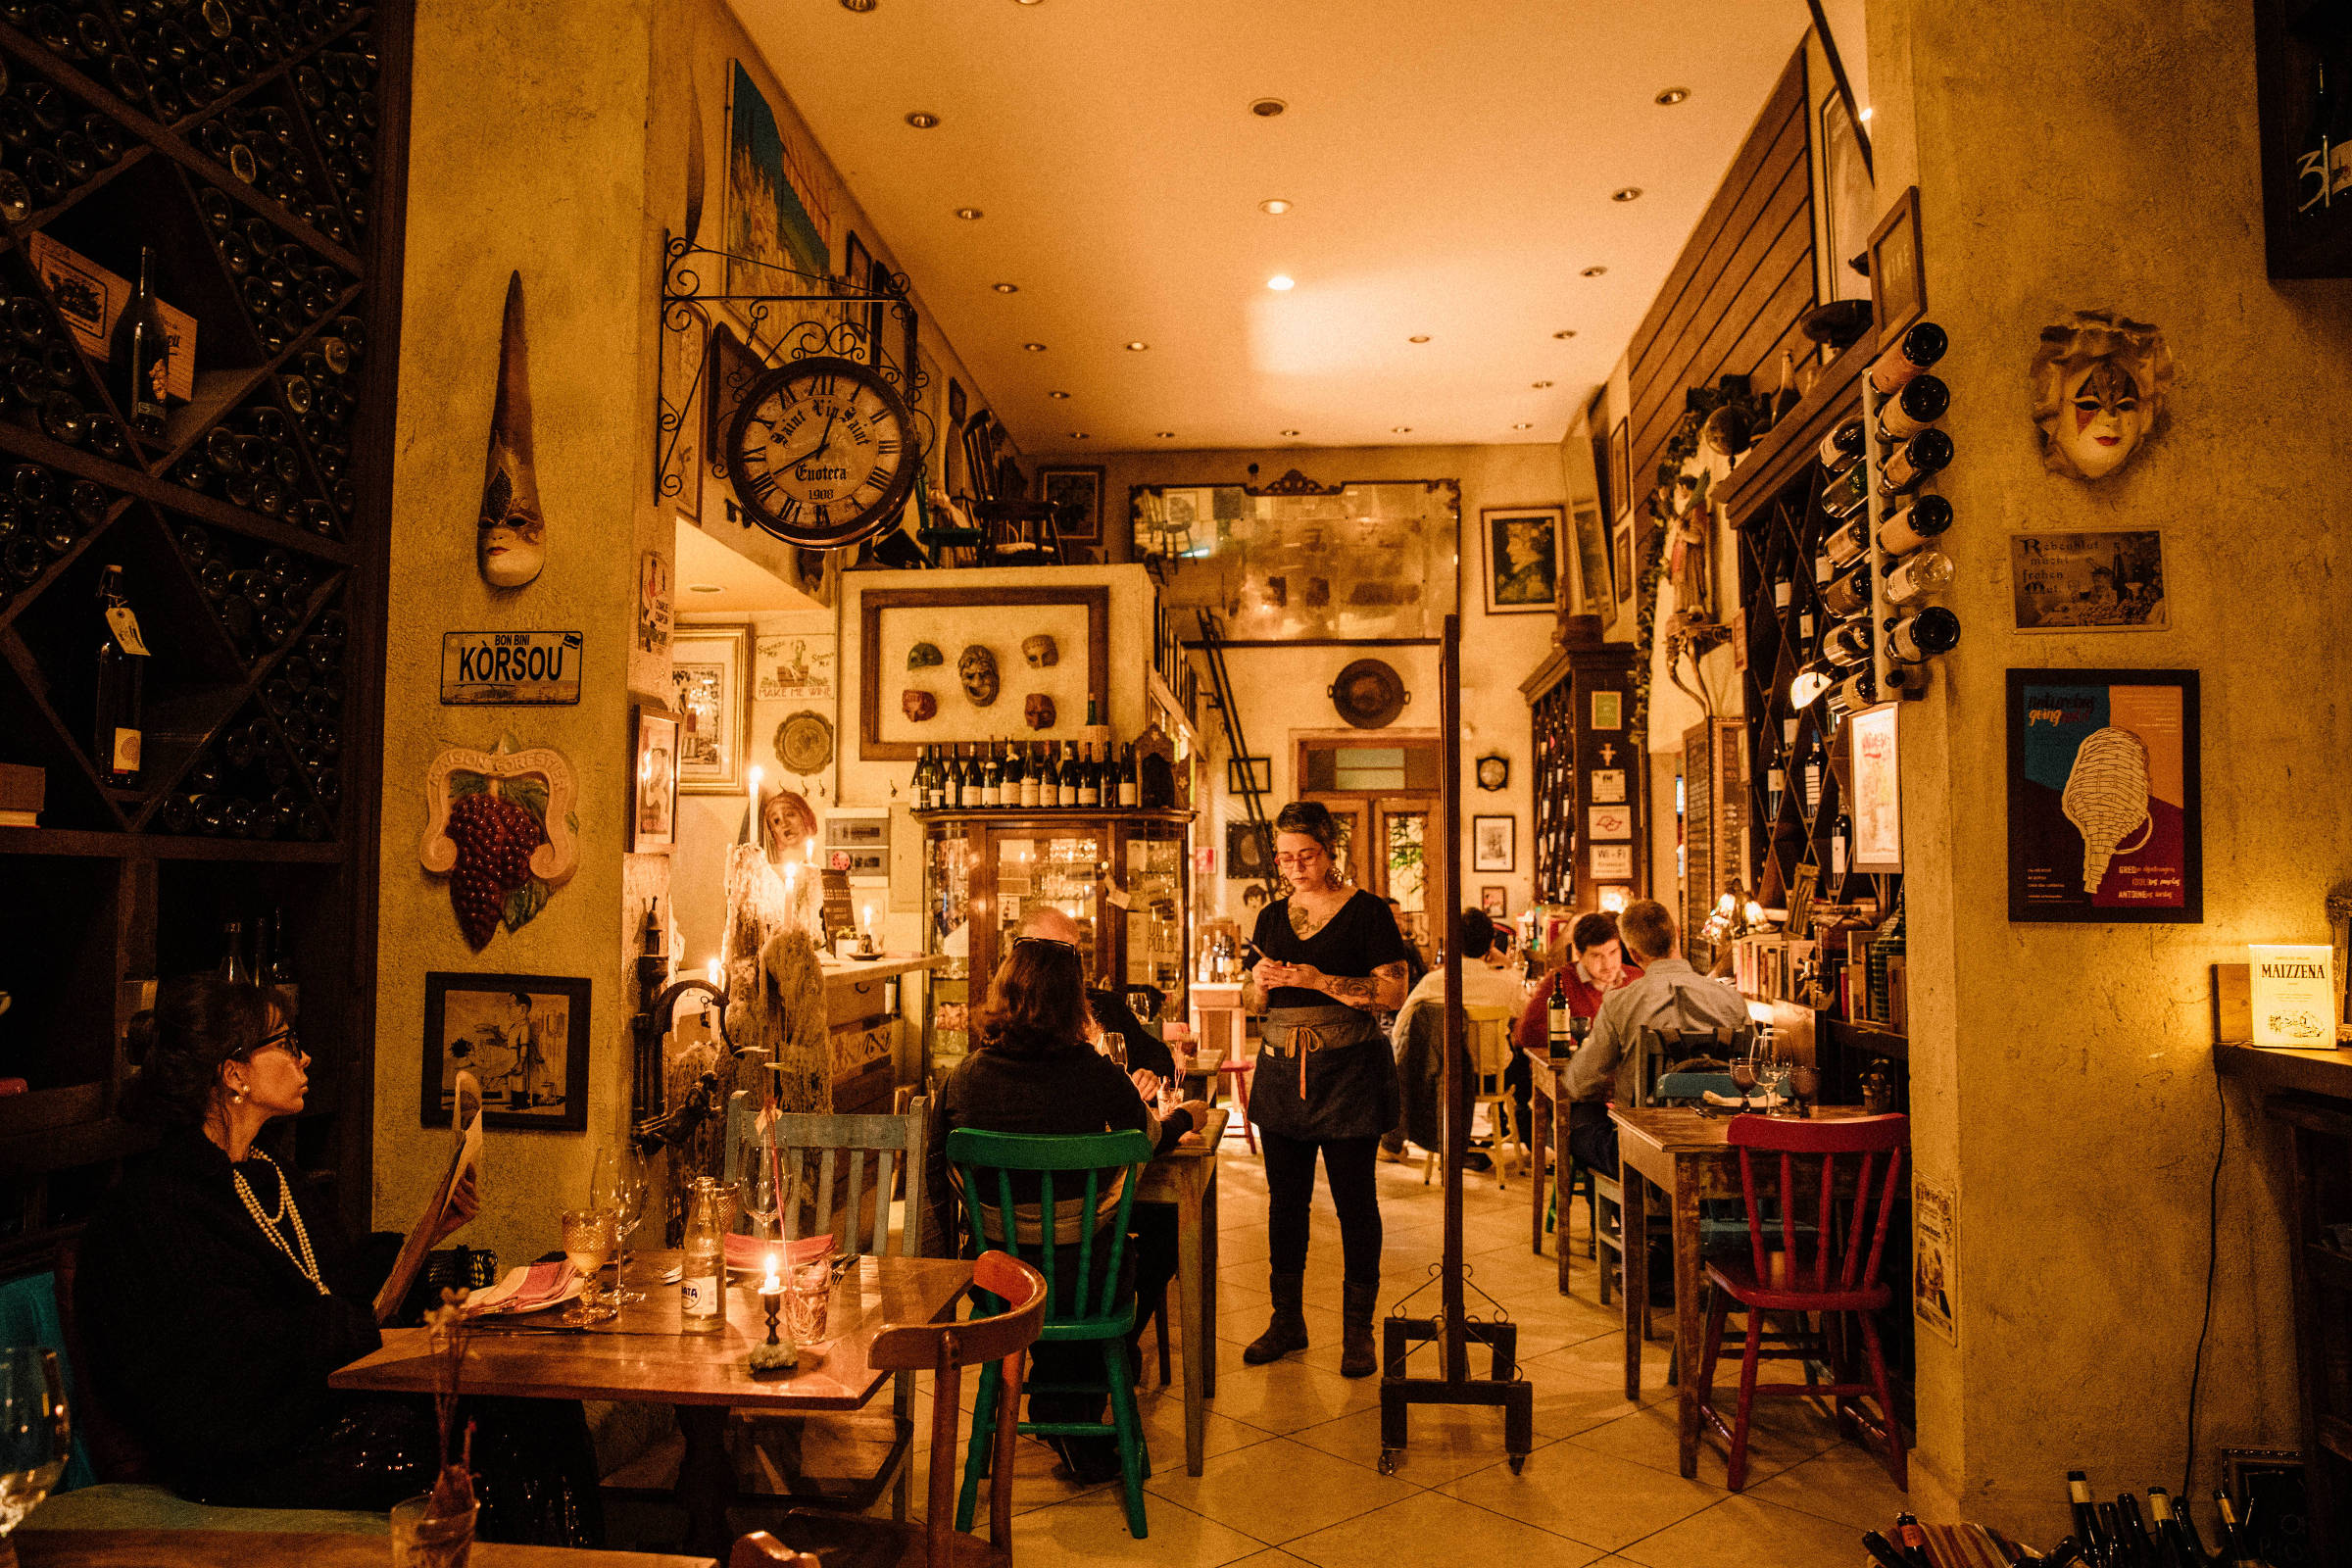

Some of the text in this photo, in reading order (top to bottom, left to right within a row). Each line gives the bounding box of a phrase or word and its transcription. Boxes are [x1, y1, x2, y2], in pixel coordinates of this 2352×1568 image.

[770, 409, 807, 450] Saint
[839, 406, 872, 447] Saint
[795, 462, 848, 482] Enoteca
[494, 634, 530, 646] BON BINI
[460, 640, 564, 682] KÒRSOU
[2261, 963, 2326, 979] MAIZZENA
